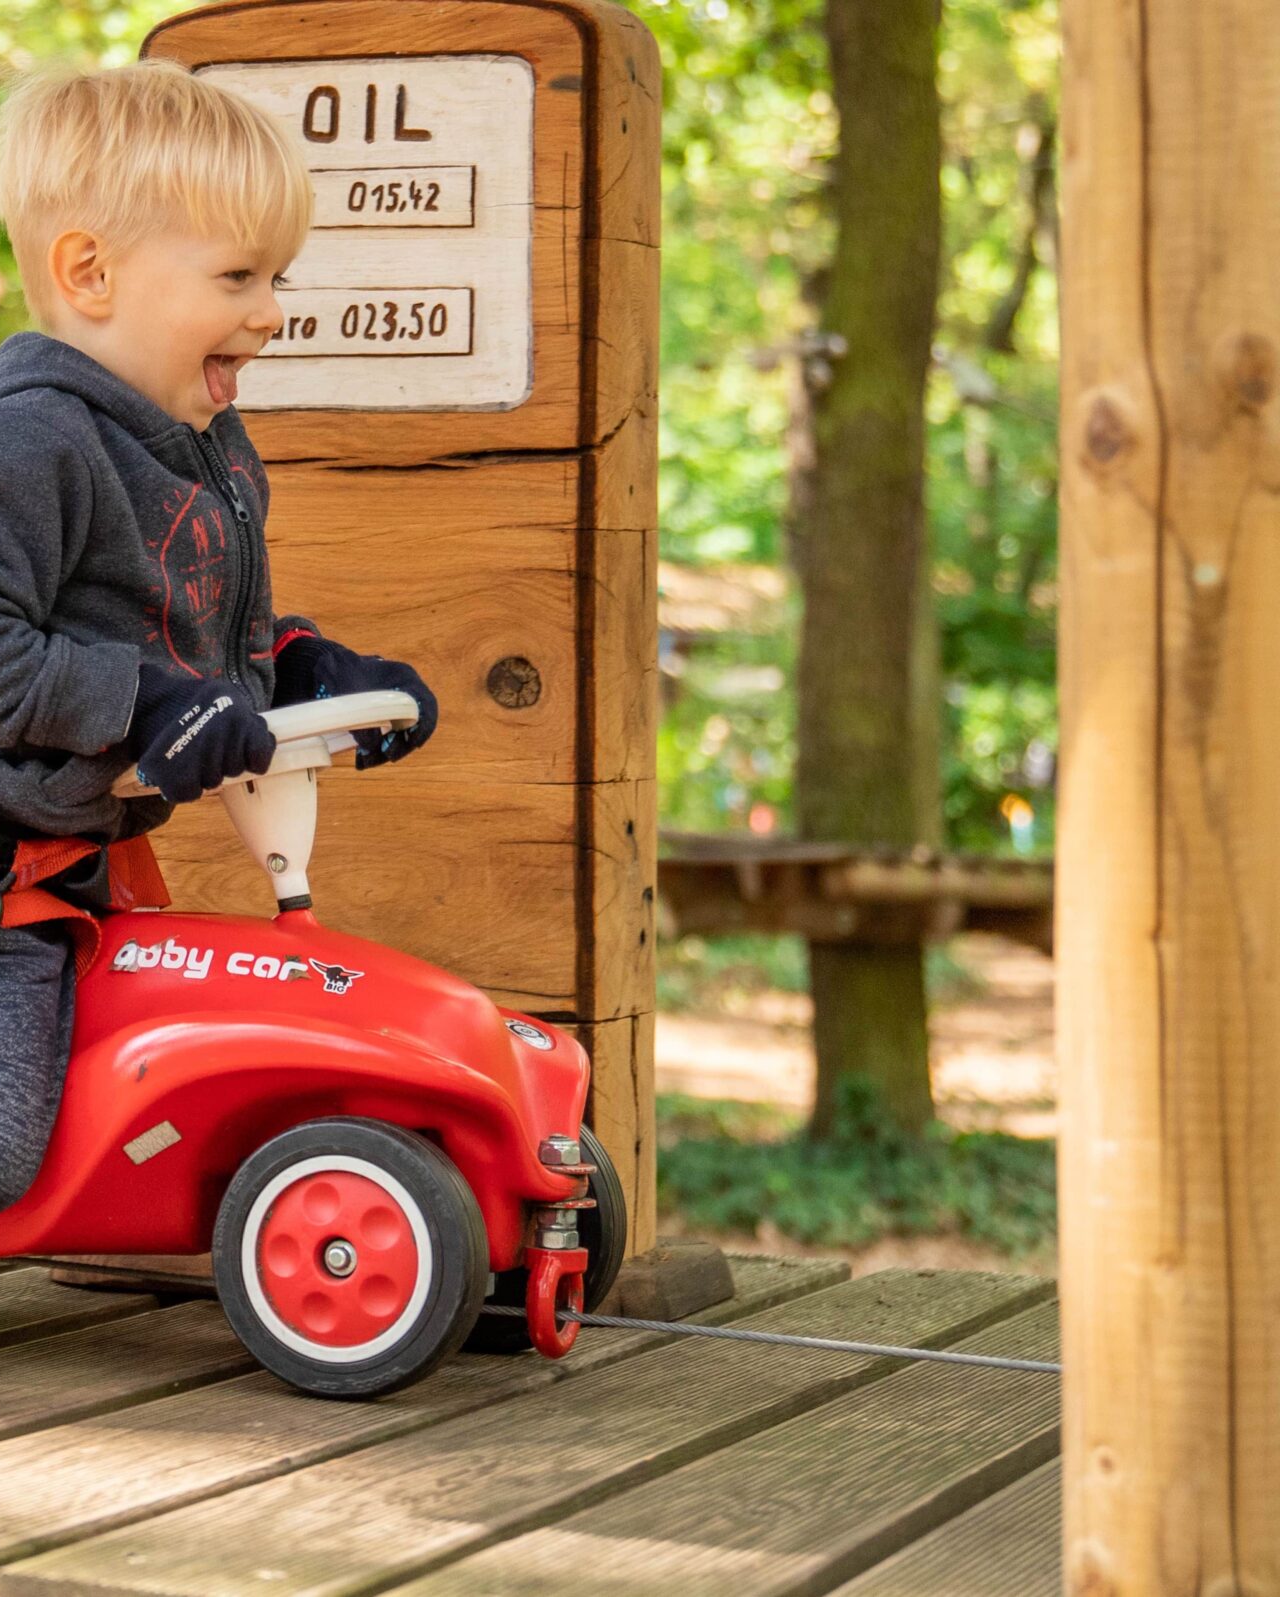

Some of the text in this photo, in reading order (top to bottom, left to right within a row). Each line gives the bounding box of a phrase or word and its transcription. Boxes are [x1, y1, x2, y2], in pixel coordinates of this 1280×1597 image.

[302, 84, 433, 144] OIL
[347, 180, 440, 213] 015,42
[225, 952, 309, 981] car
[325, 982, 346, 993] BIG
